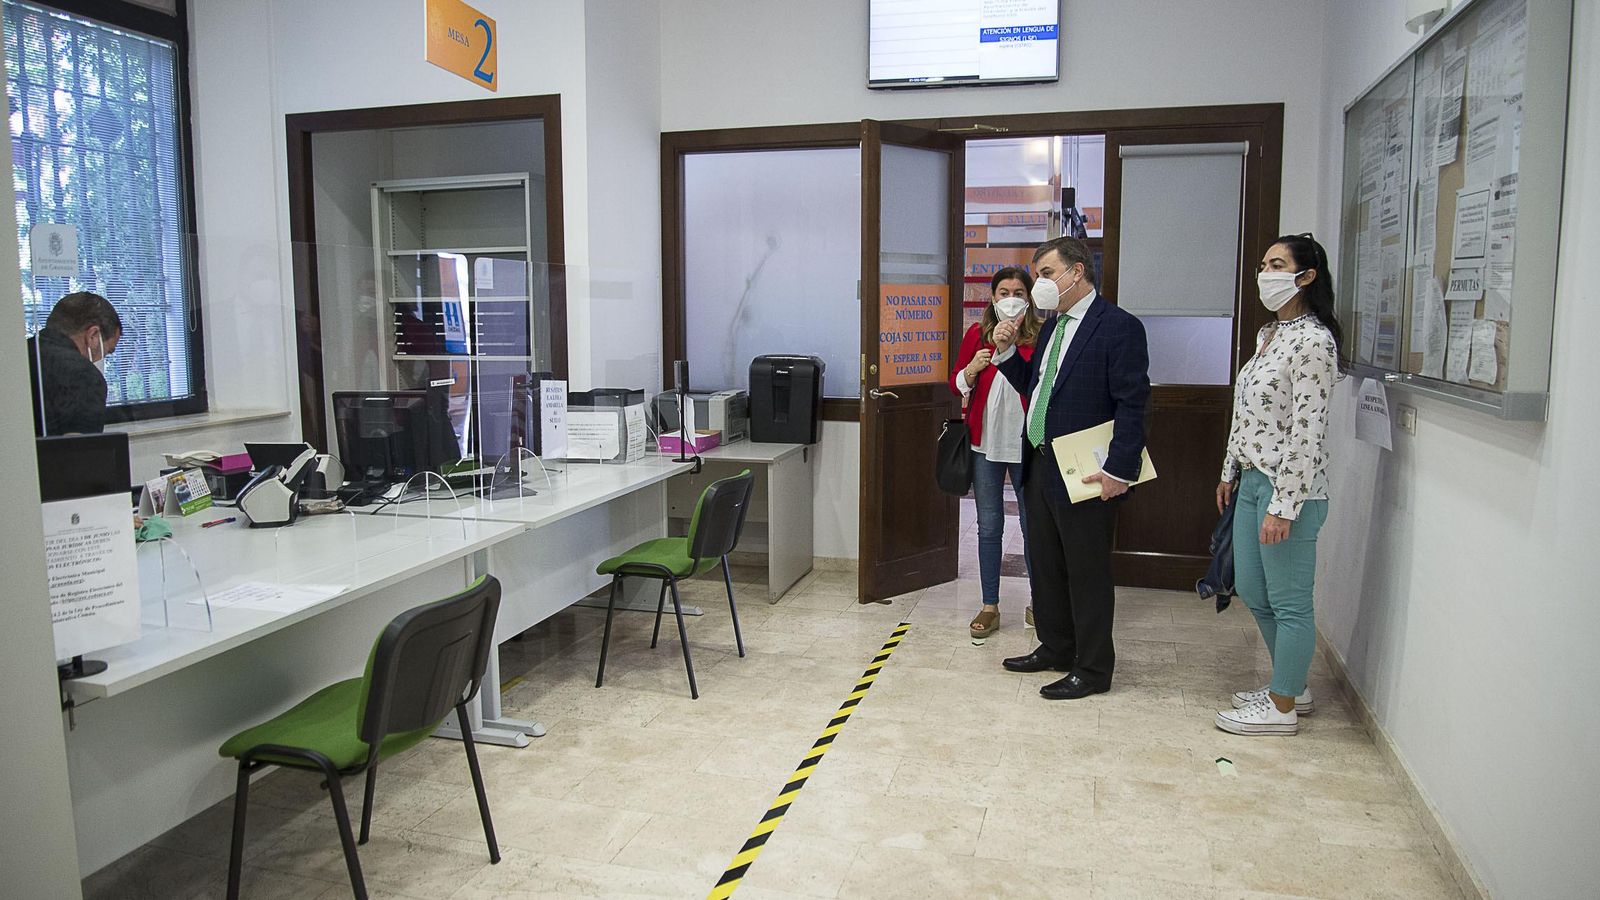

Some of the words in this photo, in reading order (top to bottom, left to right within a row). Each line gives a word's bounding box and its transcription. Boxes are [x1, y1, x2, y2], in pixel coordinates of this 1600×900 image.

[447, 27, 470, 47] MESA
[473, 18, 494, 84] 2
[1008, 215, 1035, 225] SALA
[1449, 278, 1480, 292] PERMUTAS
[886, 296, 899, 306] NO
[901, 296, 926, 306] PASAR
[928, 296, 941, 305] SIN
[895, 308, 932, 320] NÚMERO
[880, 332, 901, 344] COJA
[903, 332, 913, 342] SU
[915, 331, 947, 342] TICKET
[884, 355, 890, 363] Y
[893, 353, 919, 363] ESPERE
[922, 353, 927, 361] A
[929, 352, 942, 361] SER
[896, 365, 931, 375] LLAMADO
